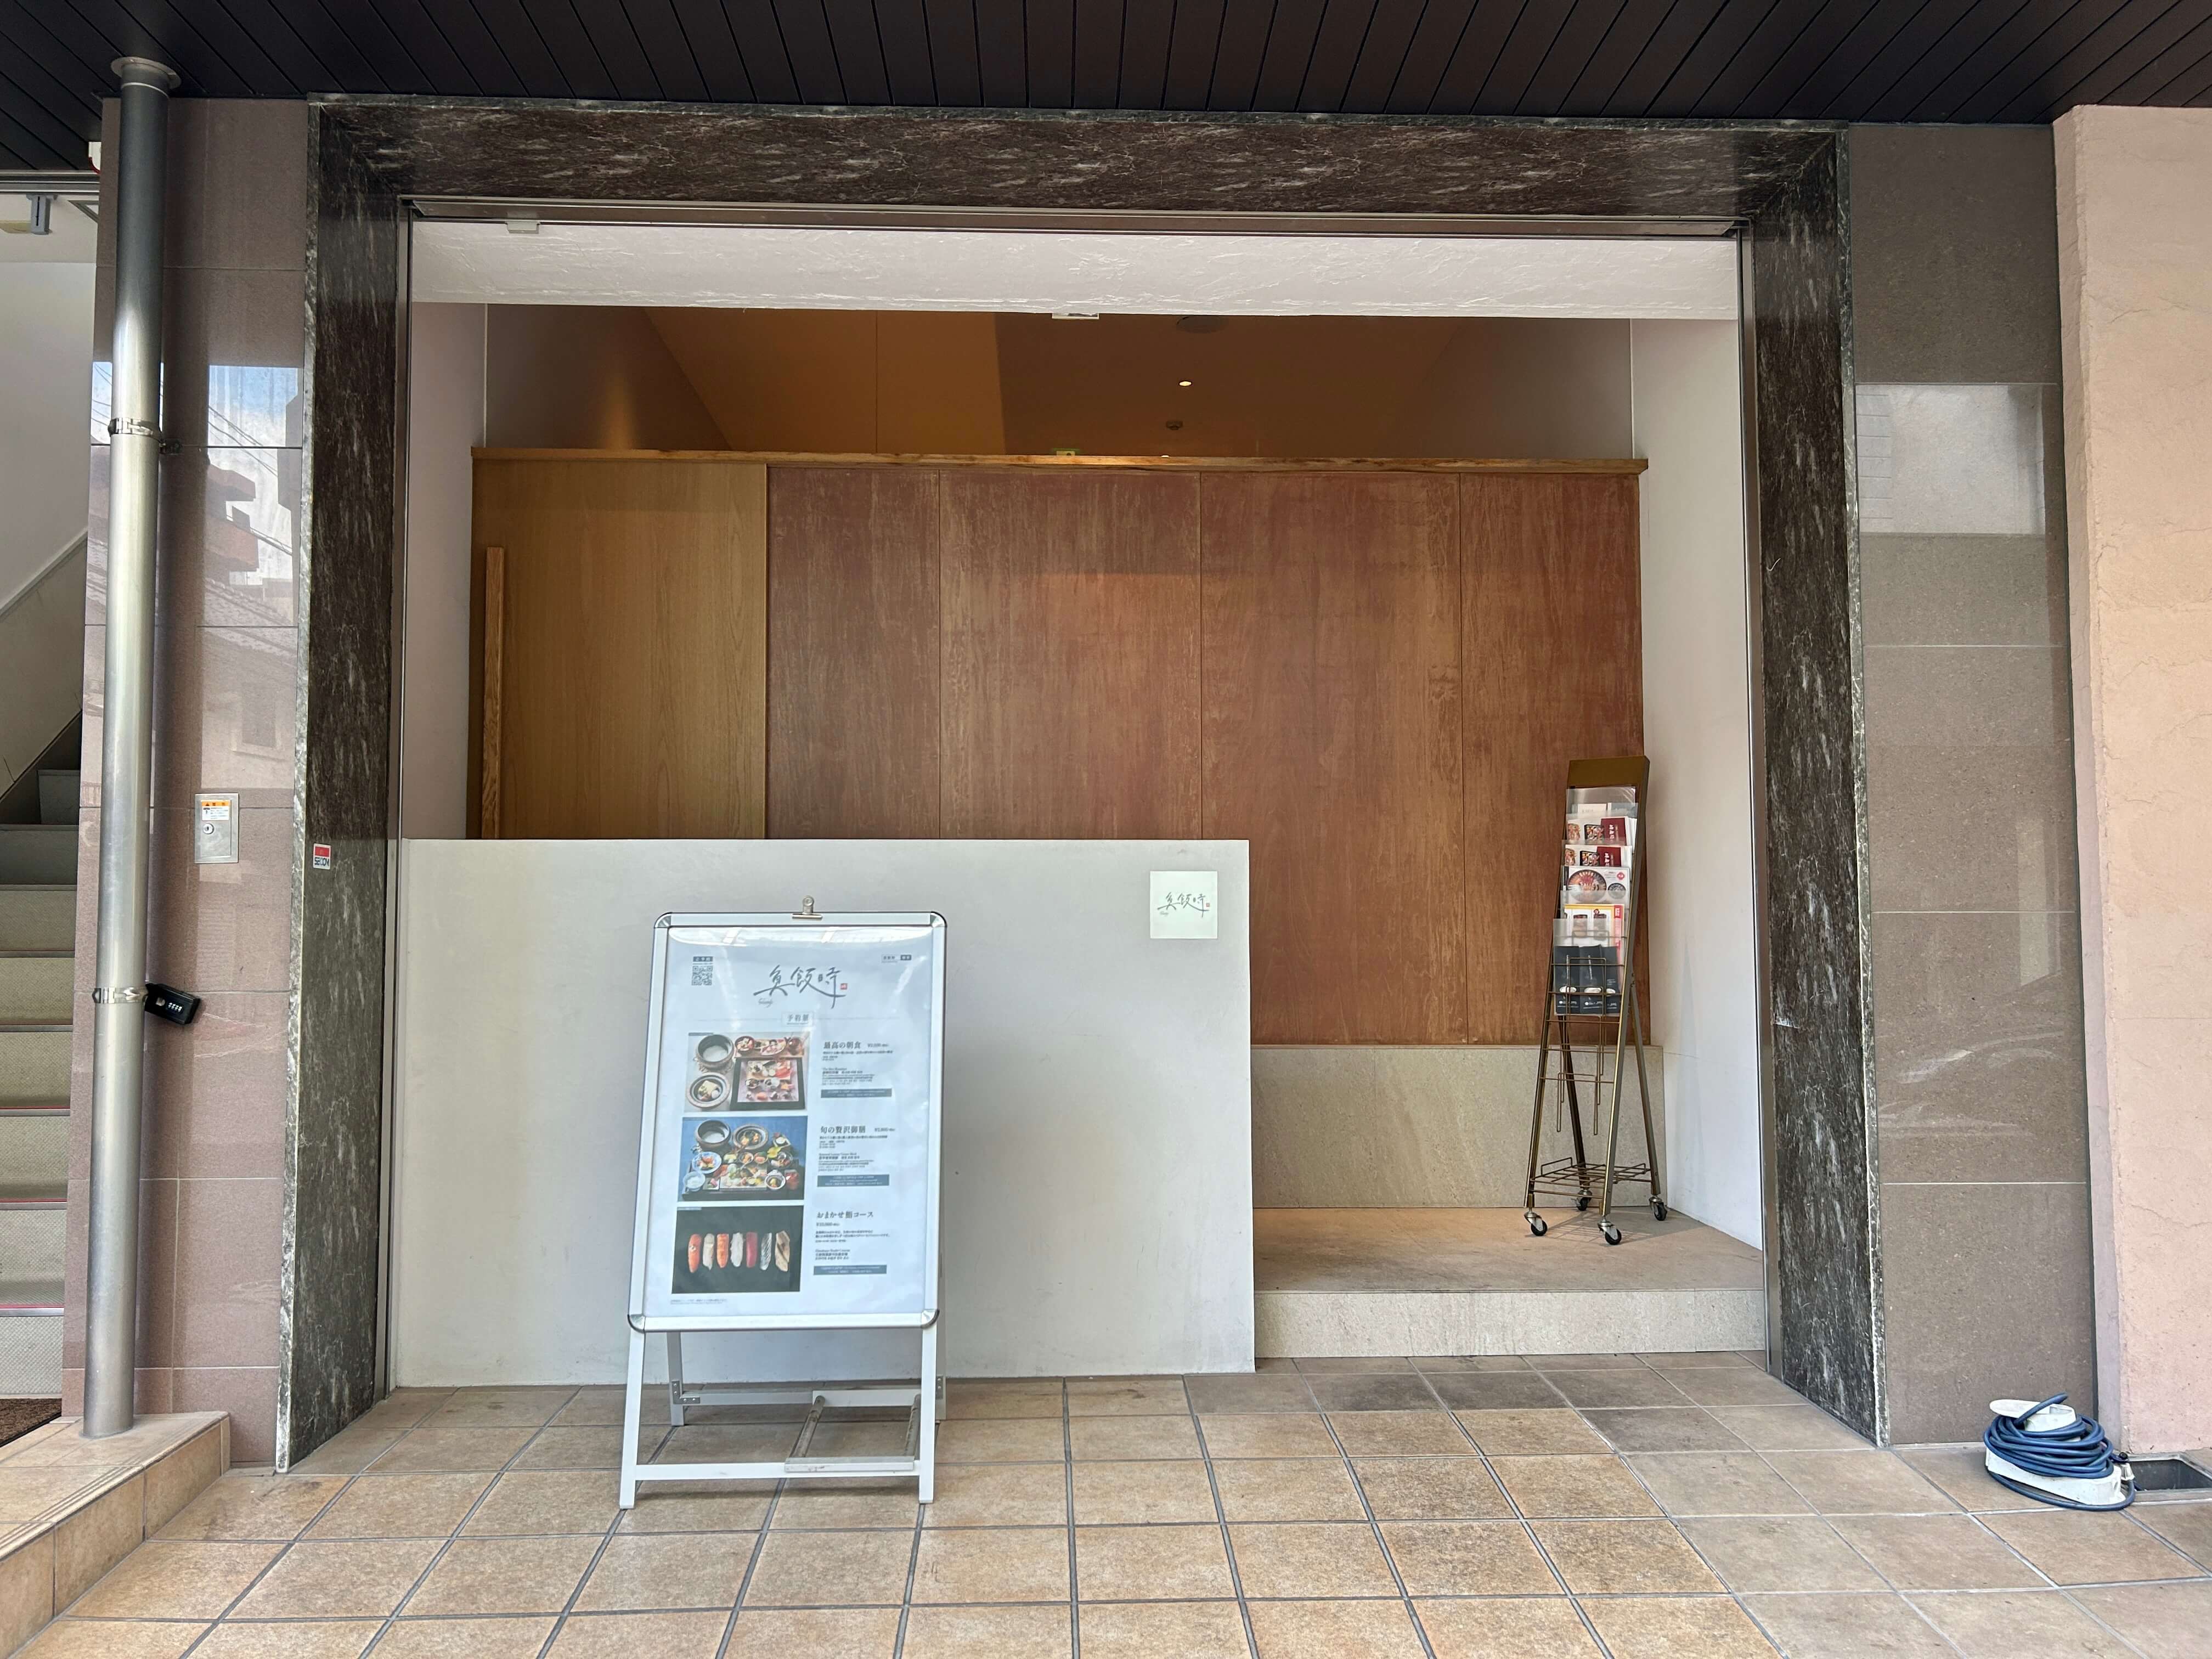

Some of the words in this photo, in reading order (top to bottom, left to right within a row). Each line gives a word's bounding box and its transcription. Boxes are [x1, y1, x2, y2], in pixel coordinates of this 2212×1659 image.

[314, 857, 330, 866] SECOM
[823, 1041, 861, 1049] 最高の朝食
